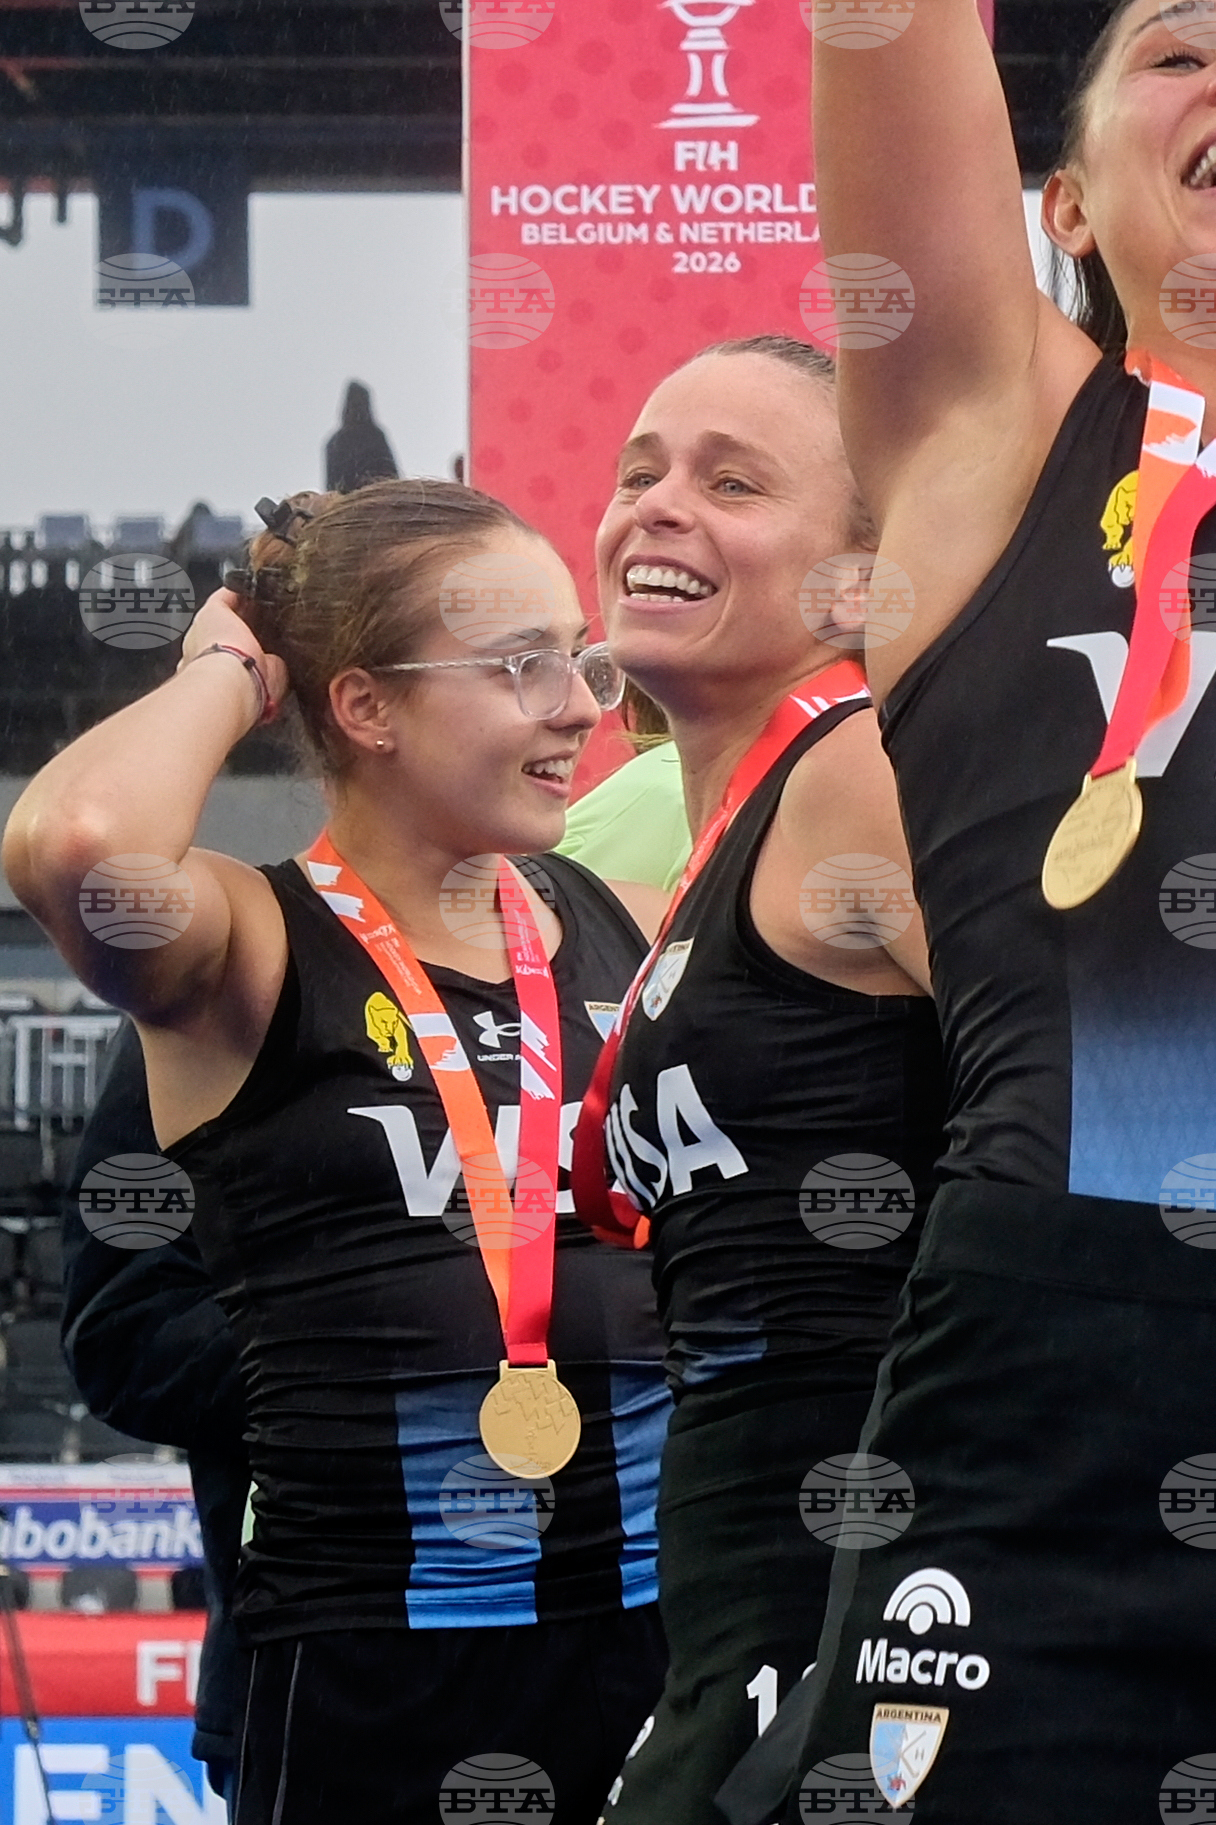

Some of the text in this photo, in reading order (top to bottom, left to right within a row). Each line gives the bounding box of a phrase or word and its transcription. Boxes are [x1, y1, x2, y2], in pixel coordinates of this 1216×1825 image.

[673, 139, 739, 173] FIH
[490, 183, 662, 216] HOCKEY
[132, 187, 213, 277] D
[520, 222, 649, 245] BELGIUM
[655, 222, 674, 244] &
[672, 251, 742, 274] 2026
[476, 1053, 514, 1062] UNDER
[0, 1505, 205, 1559] bobank
[855, 1637, 990, 1691] Macro
[876, 1707, 942, 1723] ARGENTINA
